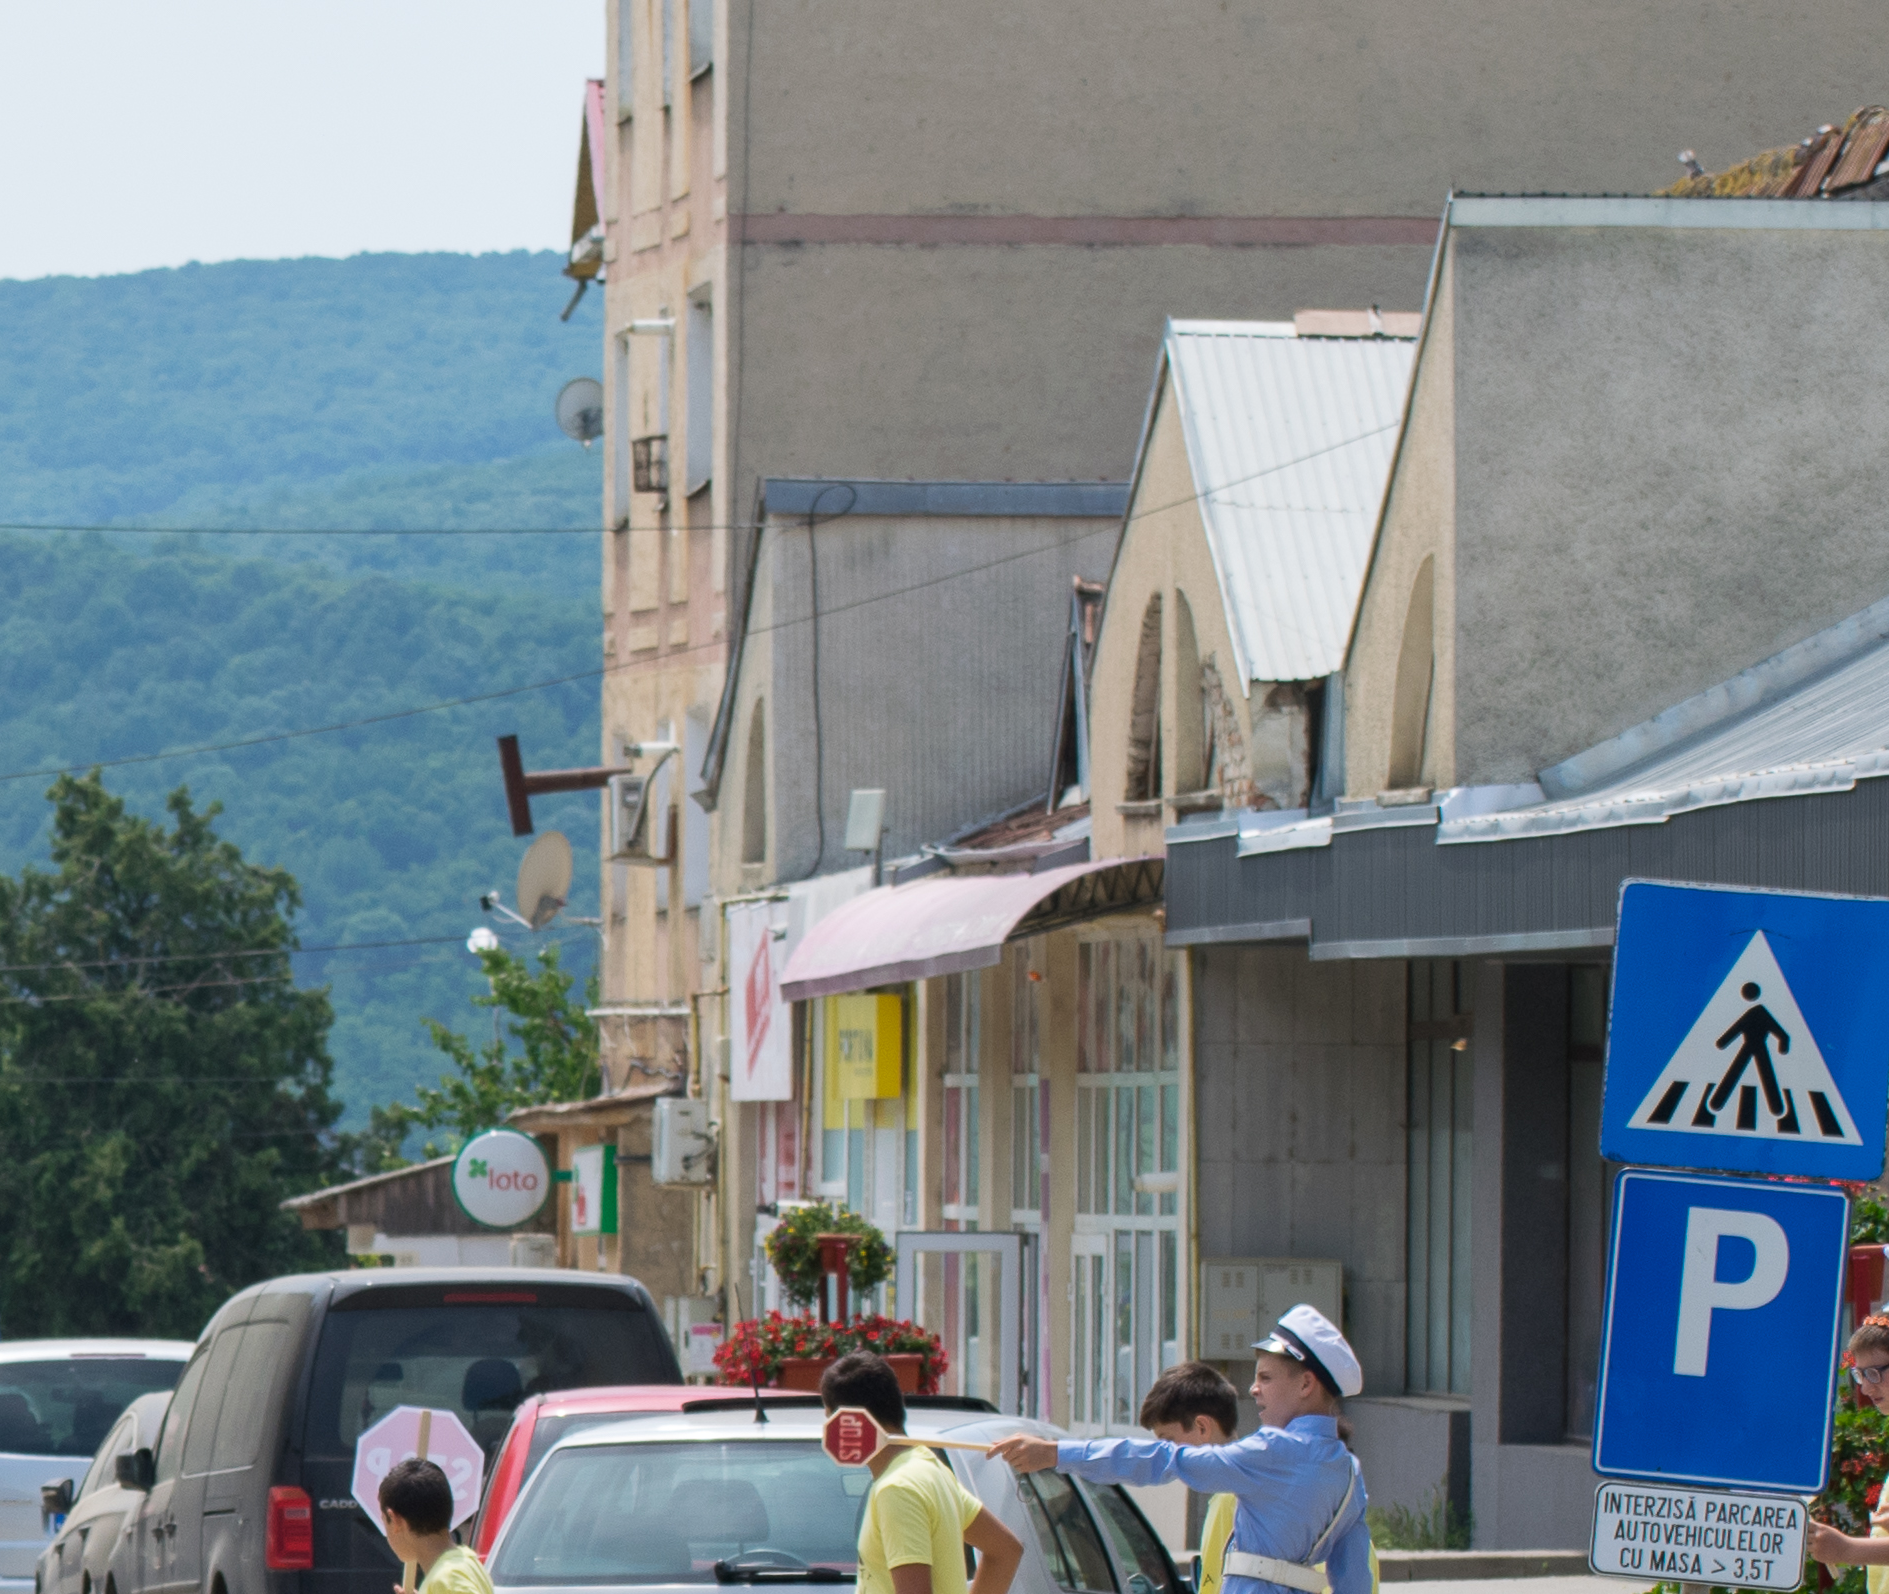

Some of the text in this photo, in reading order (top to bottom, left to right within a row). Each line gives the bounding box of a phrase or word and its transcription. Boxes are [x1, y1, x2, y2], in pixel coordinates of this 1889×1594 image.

[488, 1167, 538, 1191] loto
[1673, 1206, 1790, 1378] P
[839, 1415, 862, 1460] STOP
[319, 1499, 358, 1509] CADD
[1603, 1491, 1797, 1530] INTERZISĂ PARCAREA
[1614, 1519, 1783, 1554] AUTOVEHICULELOR
[1619, 1547, 1643, 1569] CU
[1649, 1550, 1701, 1575] MASA
[1733, 1557, 1774, 1582] 3,5T
